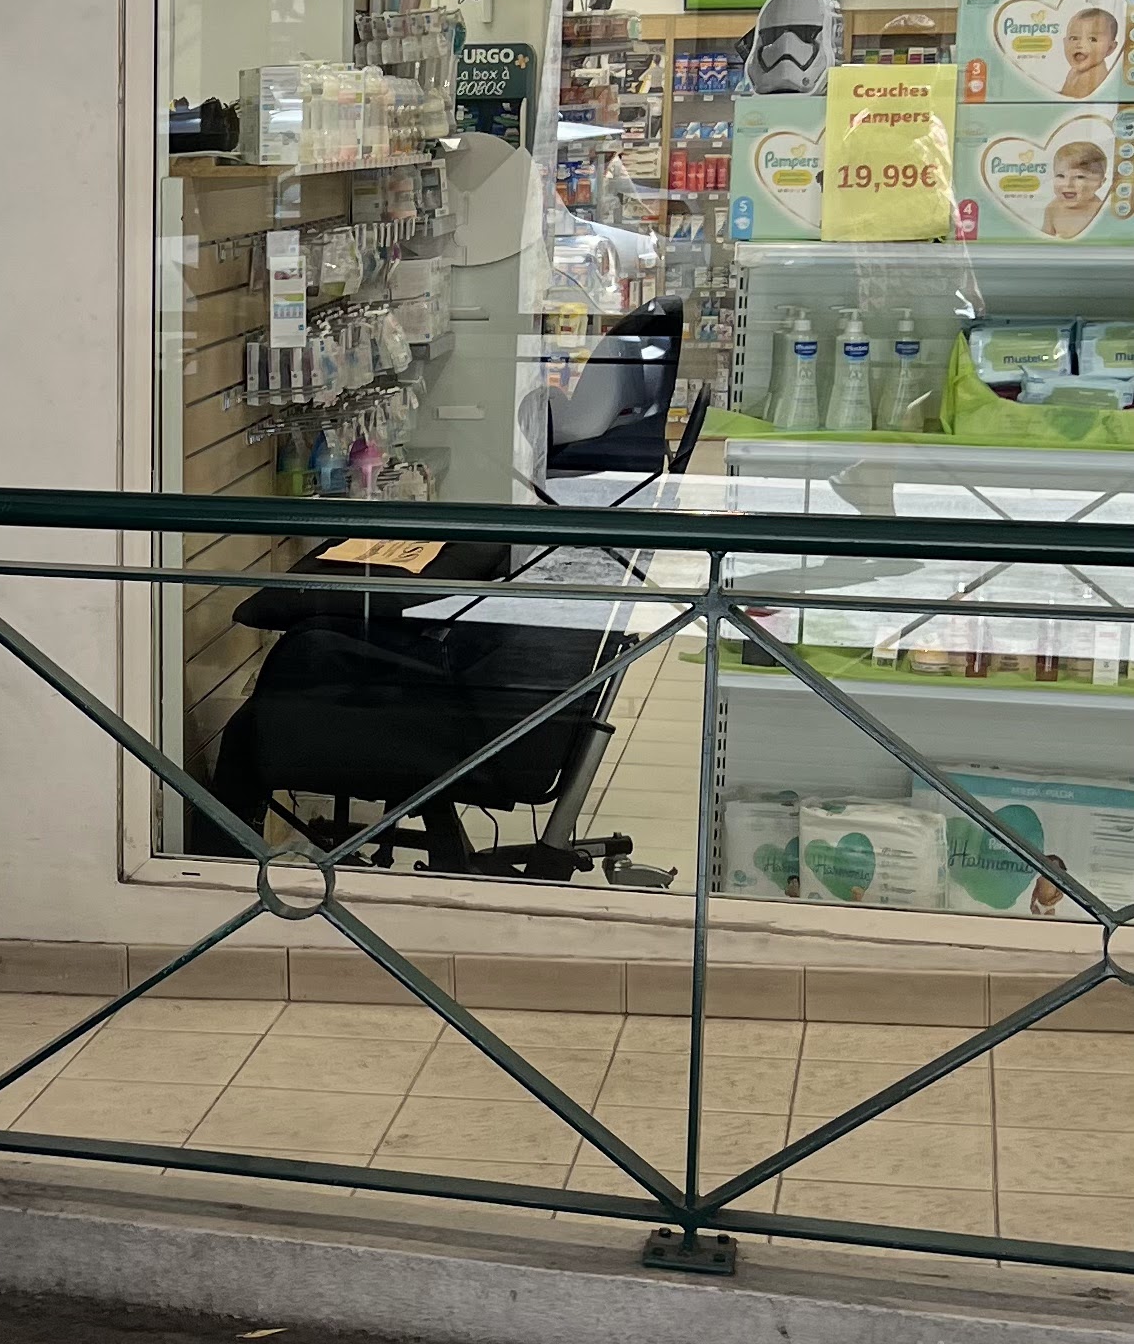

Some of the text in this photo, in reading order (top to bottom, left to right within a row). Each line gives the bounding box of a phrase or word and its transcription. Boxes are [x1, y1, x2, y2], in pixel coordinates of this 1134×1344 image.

[1004, 17, 1060, 36] Pampers
[463, 48, 515, 64] URGO
[473, 67, 498, 80] box
[501, 65, 510, 80] à
[972, 62, 981, 75] 3
[456, 80, 506, 96] BOBOS
[853, 82, 929, 98] Couches
[765, 151, 819, 170] Pampers
[991, 156, 1048, 176] Pampers
[837, 163, 939, 193] 19,99€
[739, 202, 748, 213] 5
[963, 203, 973, 215] 4
